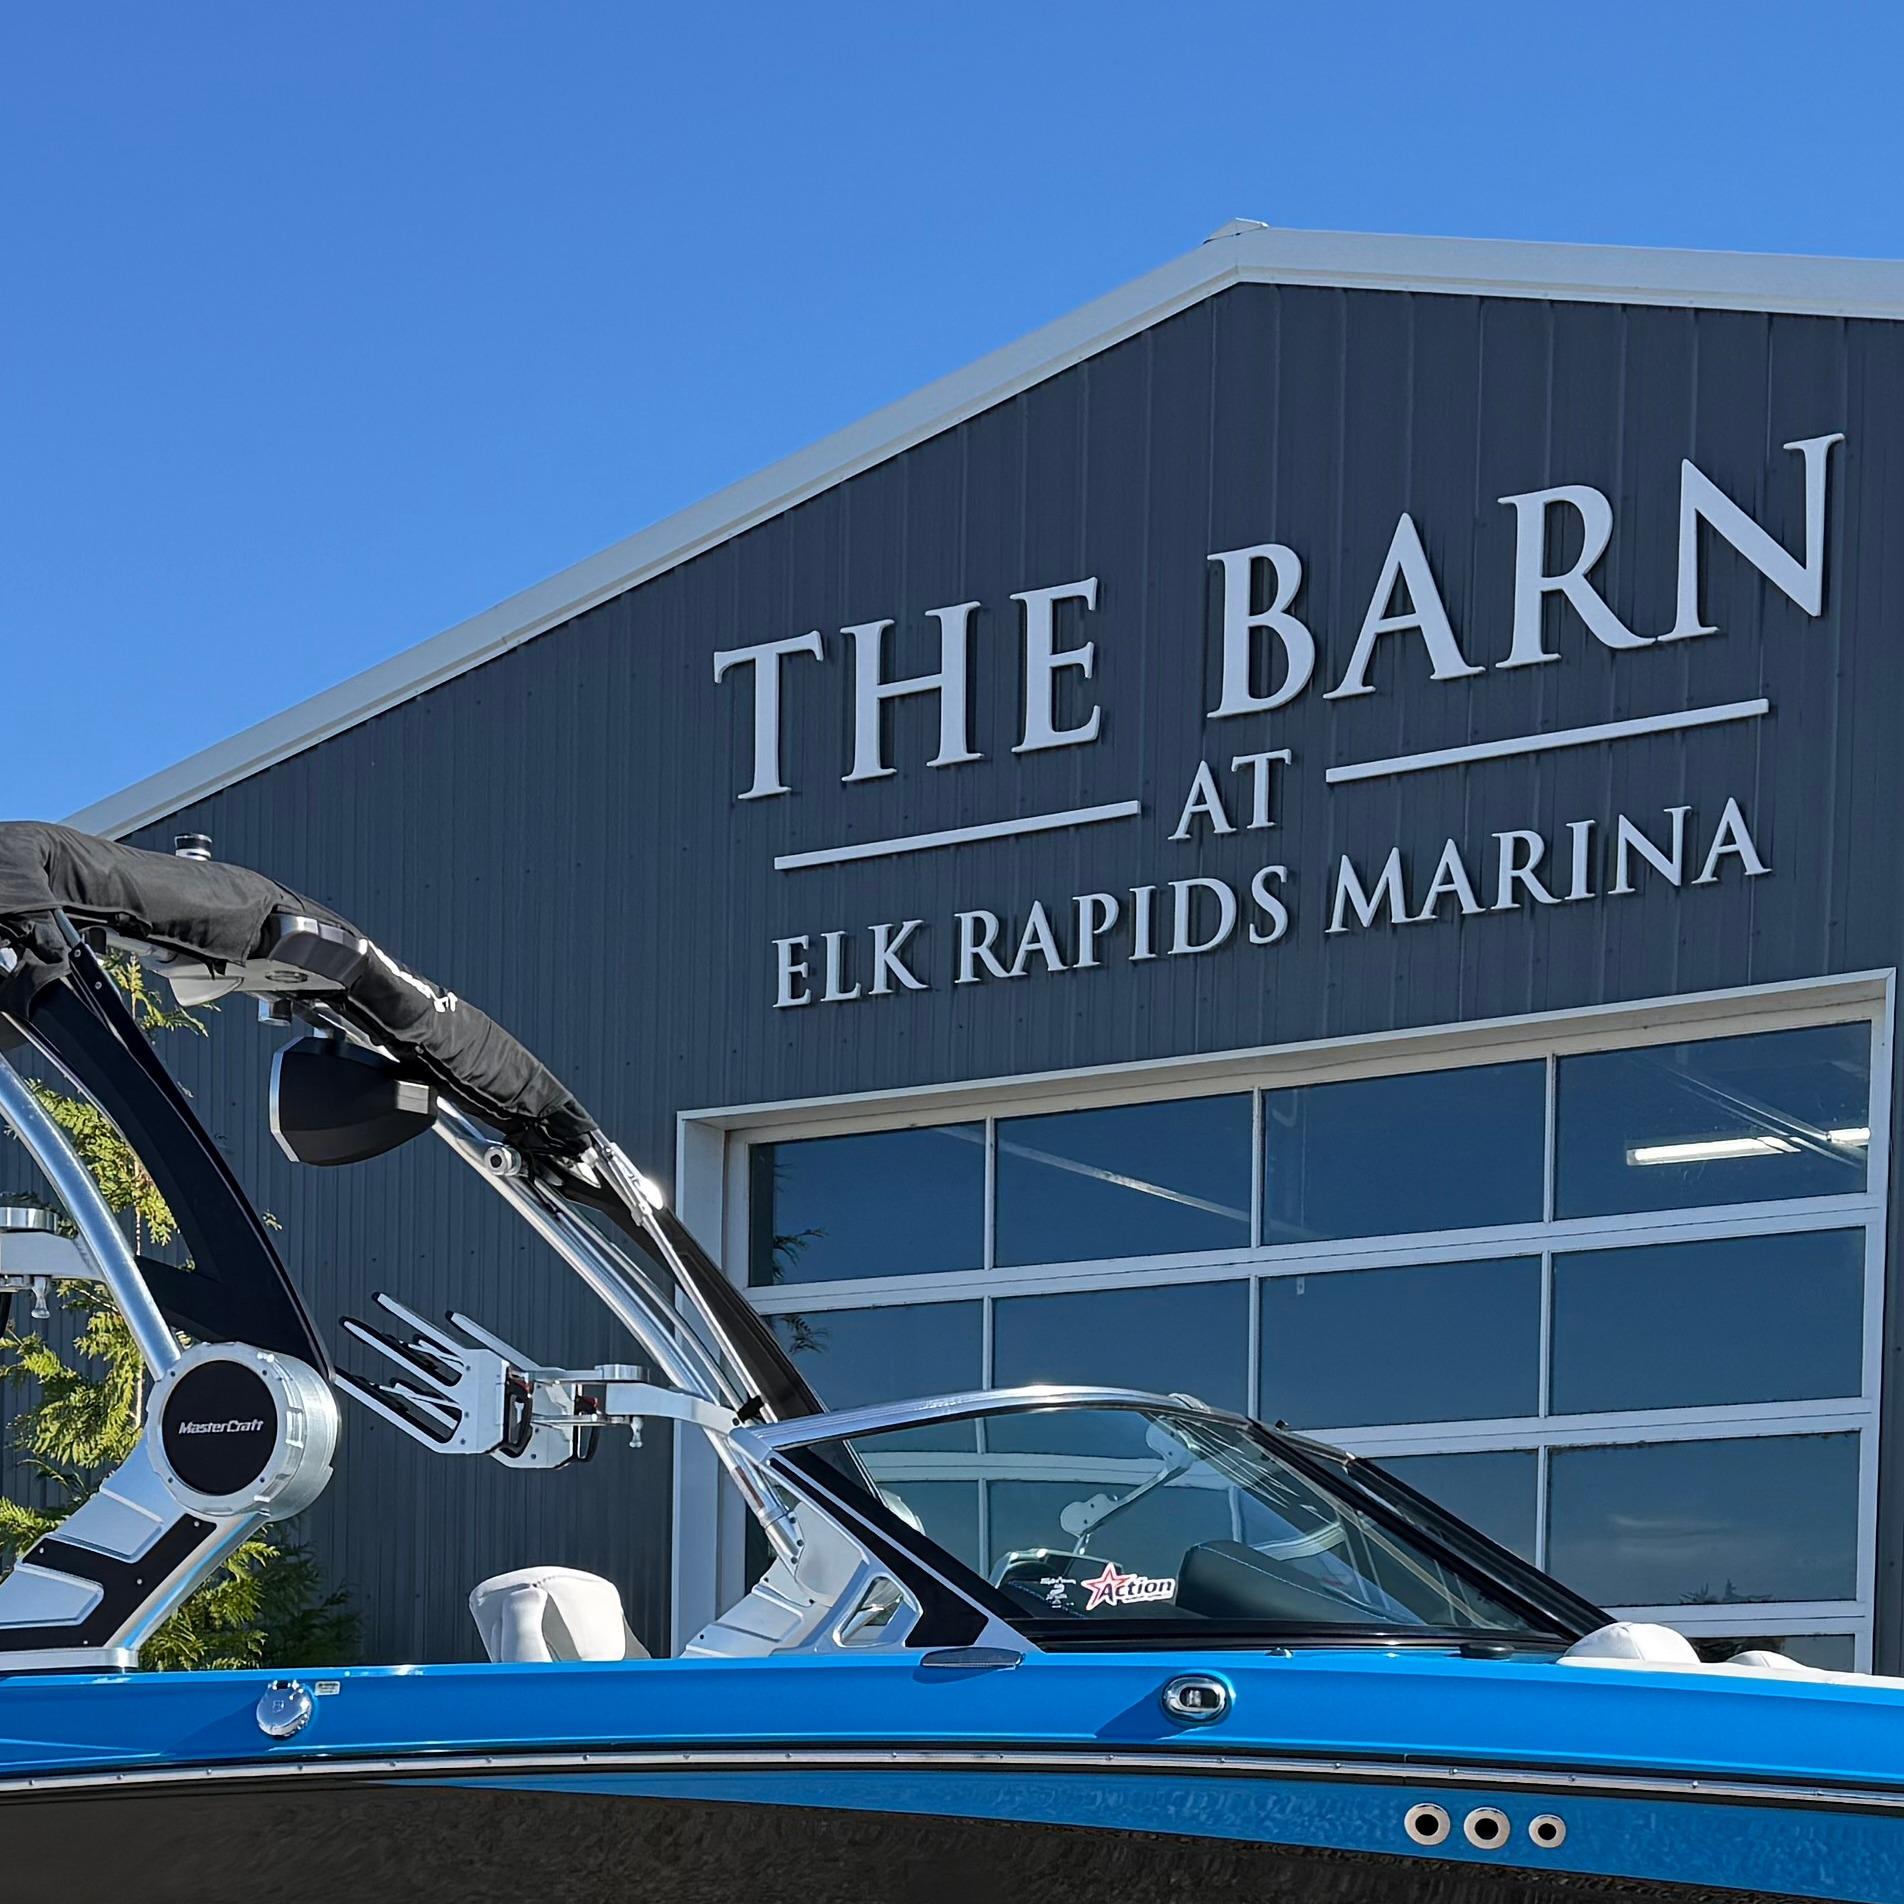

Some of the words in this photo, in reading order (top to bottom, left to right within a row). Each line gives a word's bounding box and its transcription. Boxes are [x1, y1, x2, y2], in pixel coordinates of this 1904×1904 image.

[713, 577, 1101, 800] THE
[1206, 432, 1845, 719] BARN
[1167, 748, 1291, 840] AT
[771, 919, 928, 1008] ELK
[954, 865, 1288, 985] RAPIDS
[1324, 797, 1772, 933] MARINA
[178, 1418, 264, 1435] MasterCraft
[1097, 1578, 1173, 1598] Action
